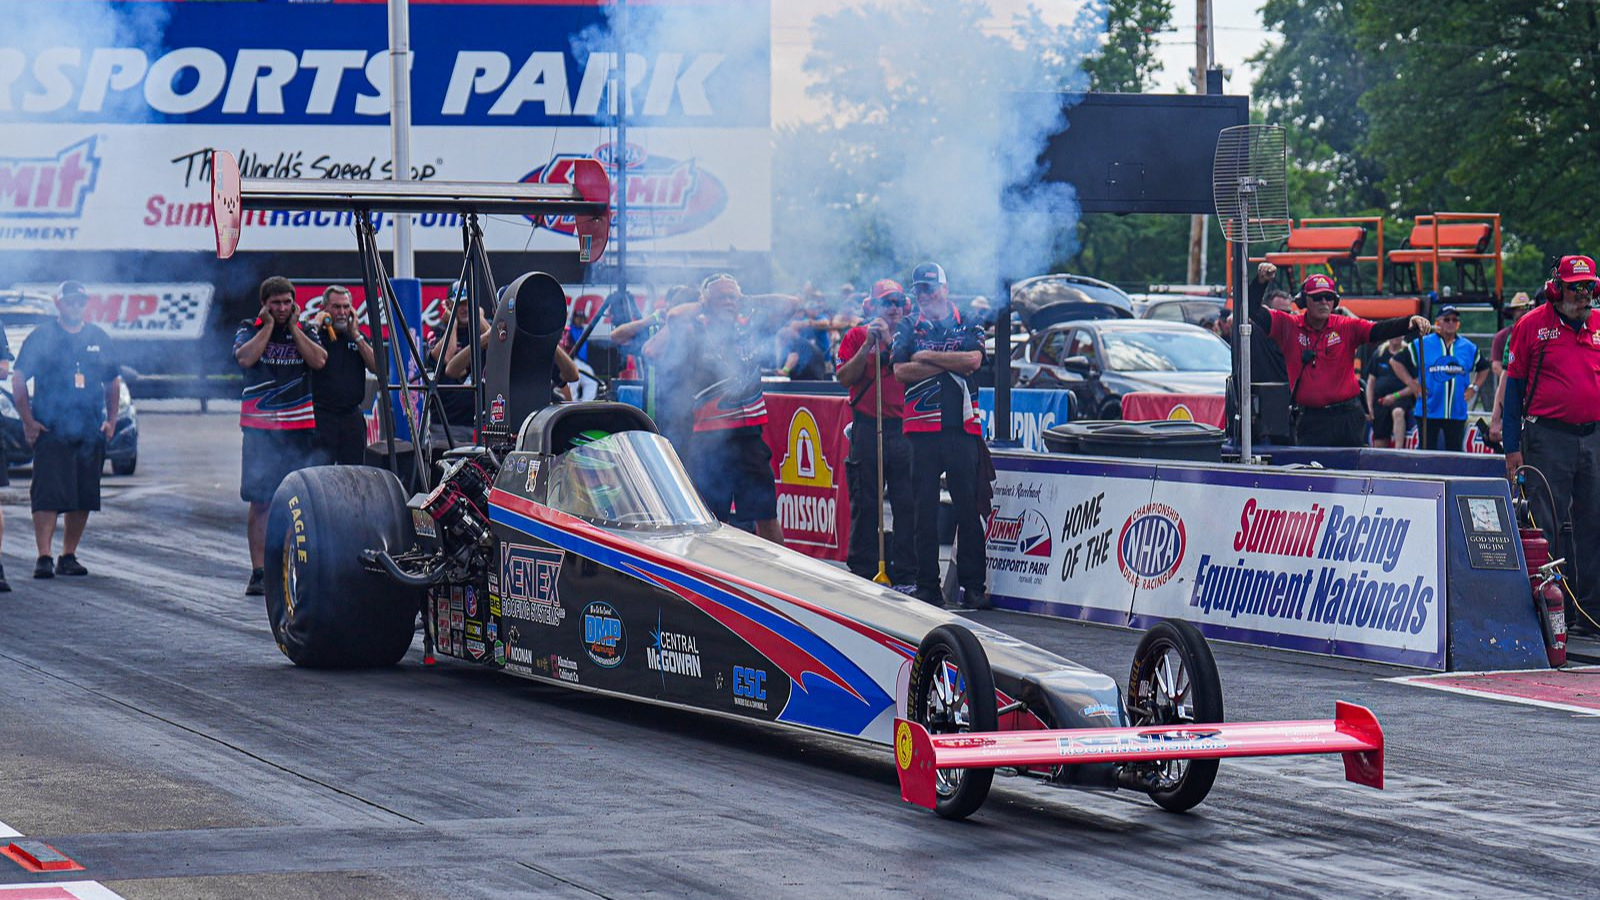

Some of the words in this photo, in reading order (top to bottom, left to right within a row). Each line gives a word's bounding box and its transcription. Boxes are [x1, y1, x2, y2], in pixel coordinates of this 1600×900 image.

[441, 51, 726, 116] PARK
[1061, 491, 1105, 543] HOME
[1132, 502, 1181, 523] CHAMPIONSHIP
[288, 495, 308, 564] EAGLE
[1125, 516, 1178, 574] NHRA
[1233, 498, 1326, 558] Summit
[1317, 504, 1411, 573] Racing
[1470, 535, 1487, 543] GOD
[1487, 535, 1510, 544] SPEED
[1061, 542, 1082, 582] OF
[1086, 527, 1113, 572] THE
[1492, 543, 1504, 551] JIM
[1028, 561, 1050, 576] PARK
[1123, 567, 1140, 588] DRAG
[1142, 573, 1168, 590] RACING
[501, 597, 531, 620] ROOFING
[530, 602, 560, 625] SYSTEMS
[1189, 554, 1315, 620] Equipment
[1306, 566, 1434, 635] Nationals
[585, 615, 622, 648] DMP
[660, 631, 700, 655] CENTRAL
[510, 646, 533, 665] NOONAN
[646, 647, 702, 678] McGOWAN
[733, 665, 767, 700] ESC
[1130, 659, 1141, 697] EAGLE
